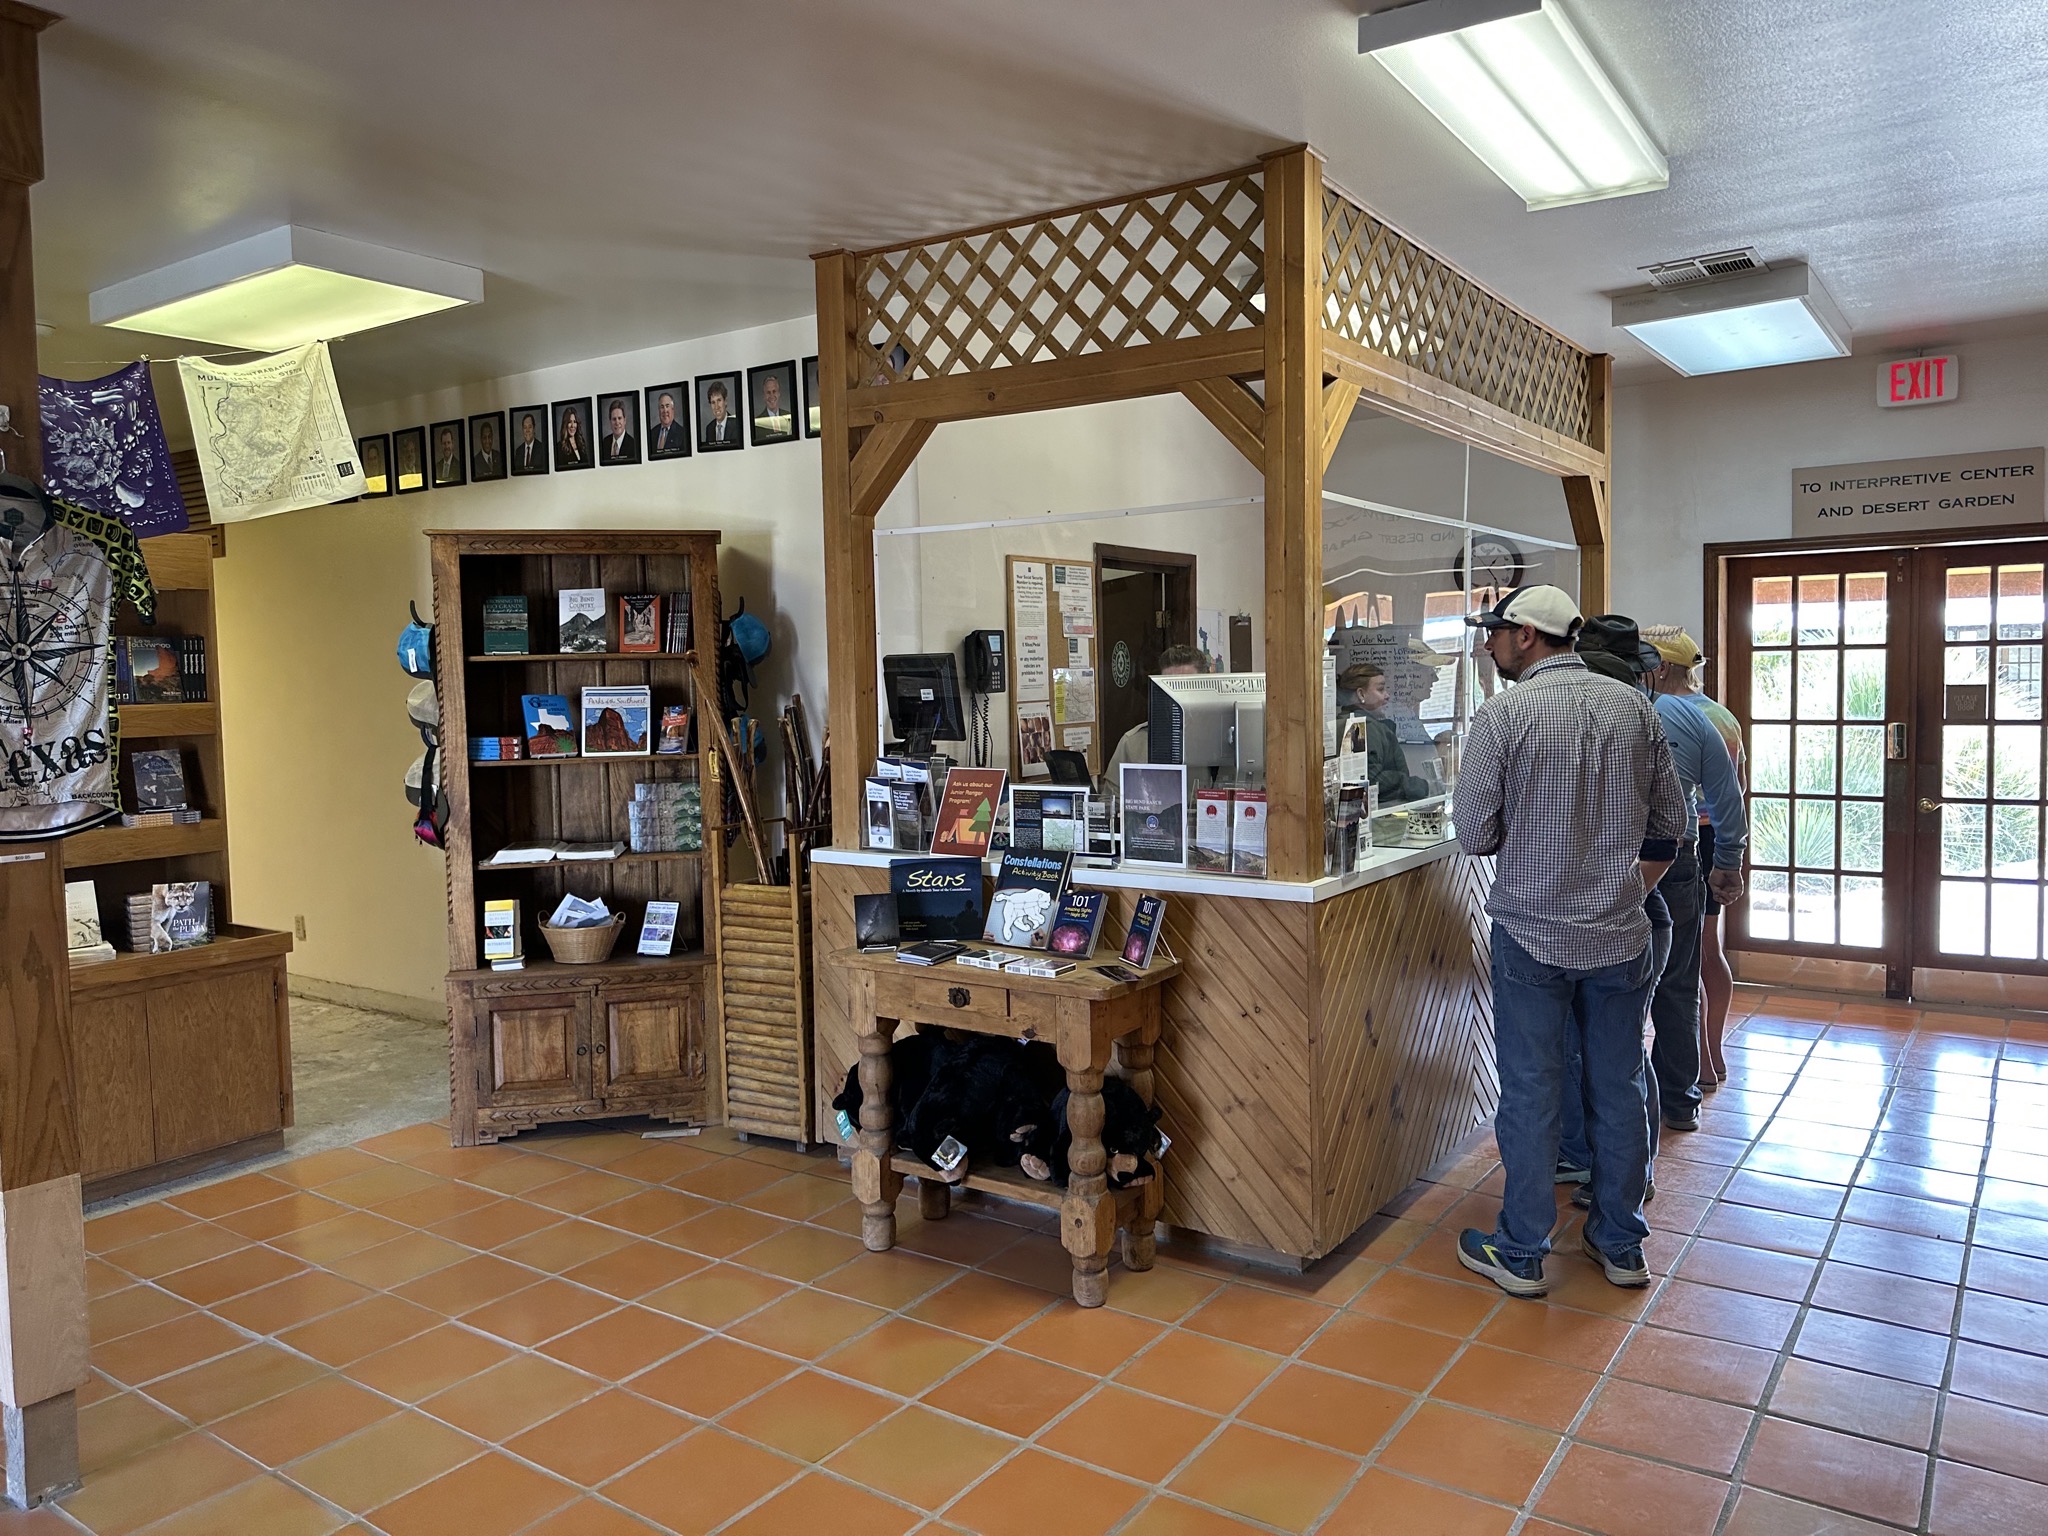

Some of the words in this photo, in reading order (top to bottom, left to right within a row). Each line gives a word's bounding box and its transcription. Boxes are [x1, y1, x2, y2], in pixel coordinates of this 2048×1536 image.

[233, 360, 297, 377] CONTRABANDO
[1889, 358, 1948, 403] EXIT
[1800, 482, 1822, 494] TO
[1829, 471, 1952, 492] INTERPRETIVE
[1959, 464, 2035, 482] CENTER
[1817, 505, 1854, 518] AND
[1861, 499, 1931, 516] DESERT
[1938, 493, 2016, 510] GARDEN
[1351, 634, 1373, 645] Water
[1376, 634, 1398, 645] Report
[616, 696, 647, 704] Southwest
[1004, 854, 1062, 870] Constellations
[906, 870, 966, 888] Stars
[1012, 866, 1042, 880] Activity
[1041, 870, 1059, 880] Book
[1072, 894, 1090, 908] 101
[1142, 900, 1153, 915] 101
[173, 918, 195, 926] PATH
